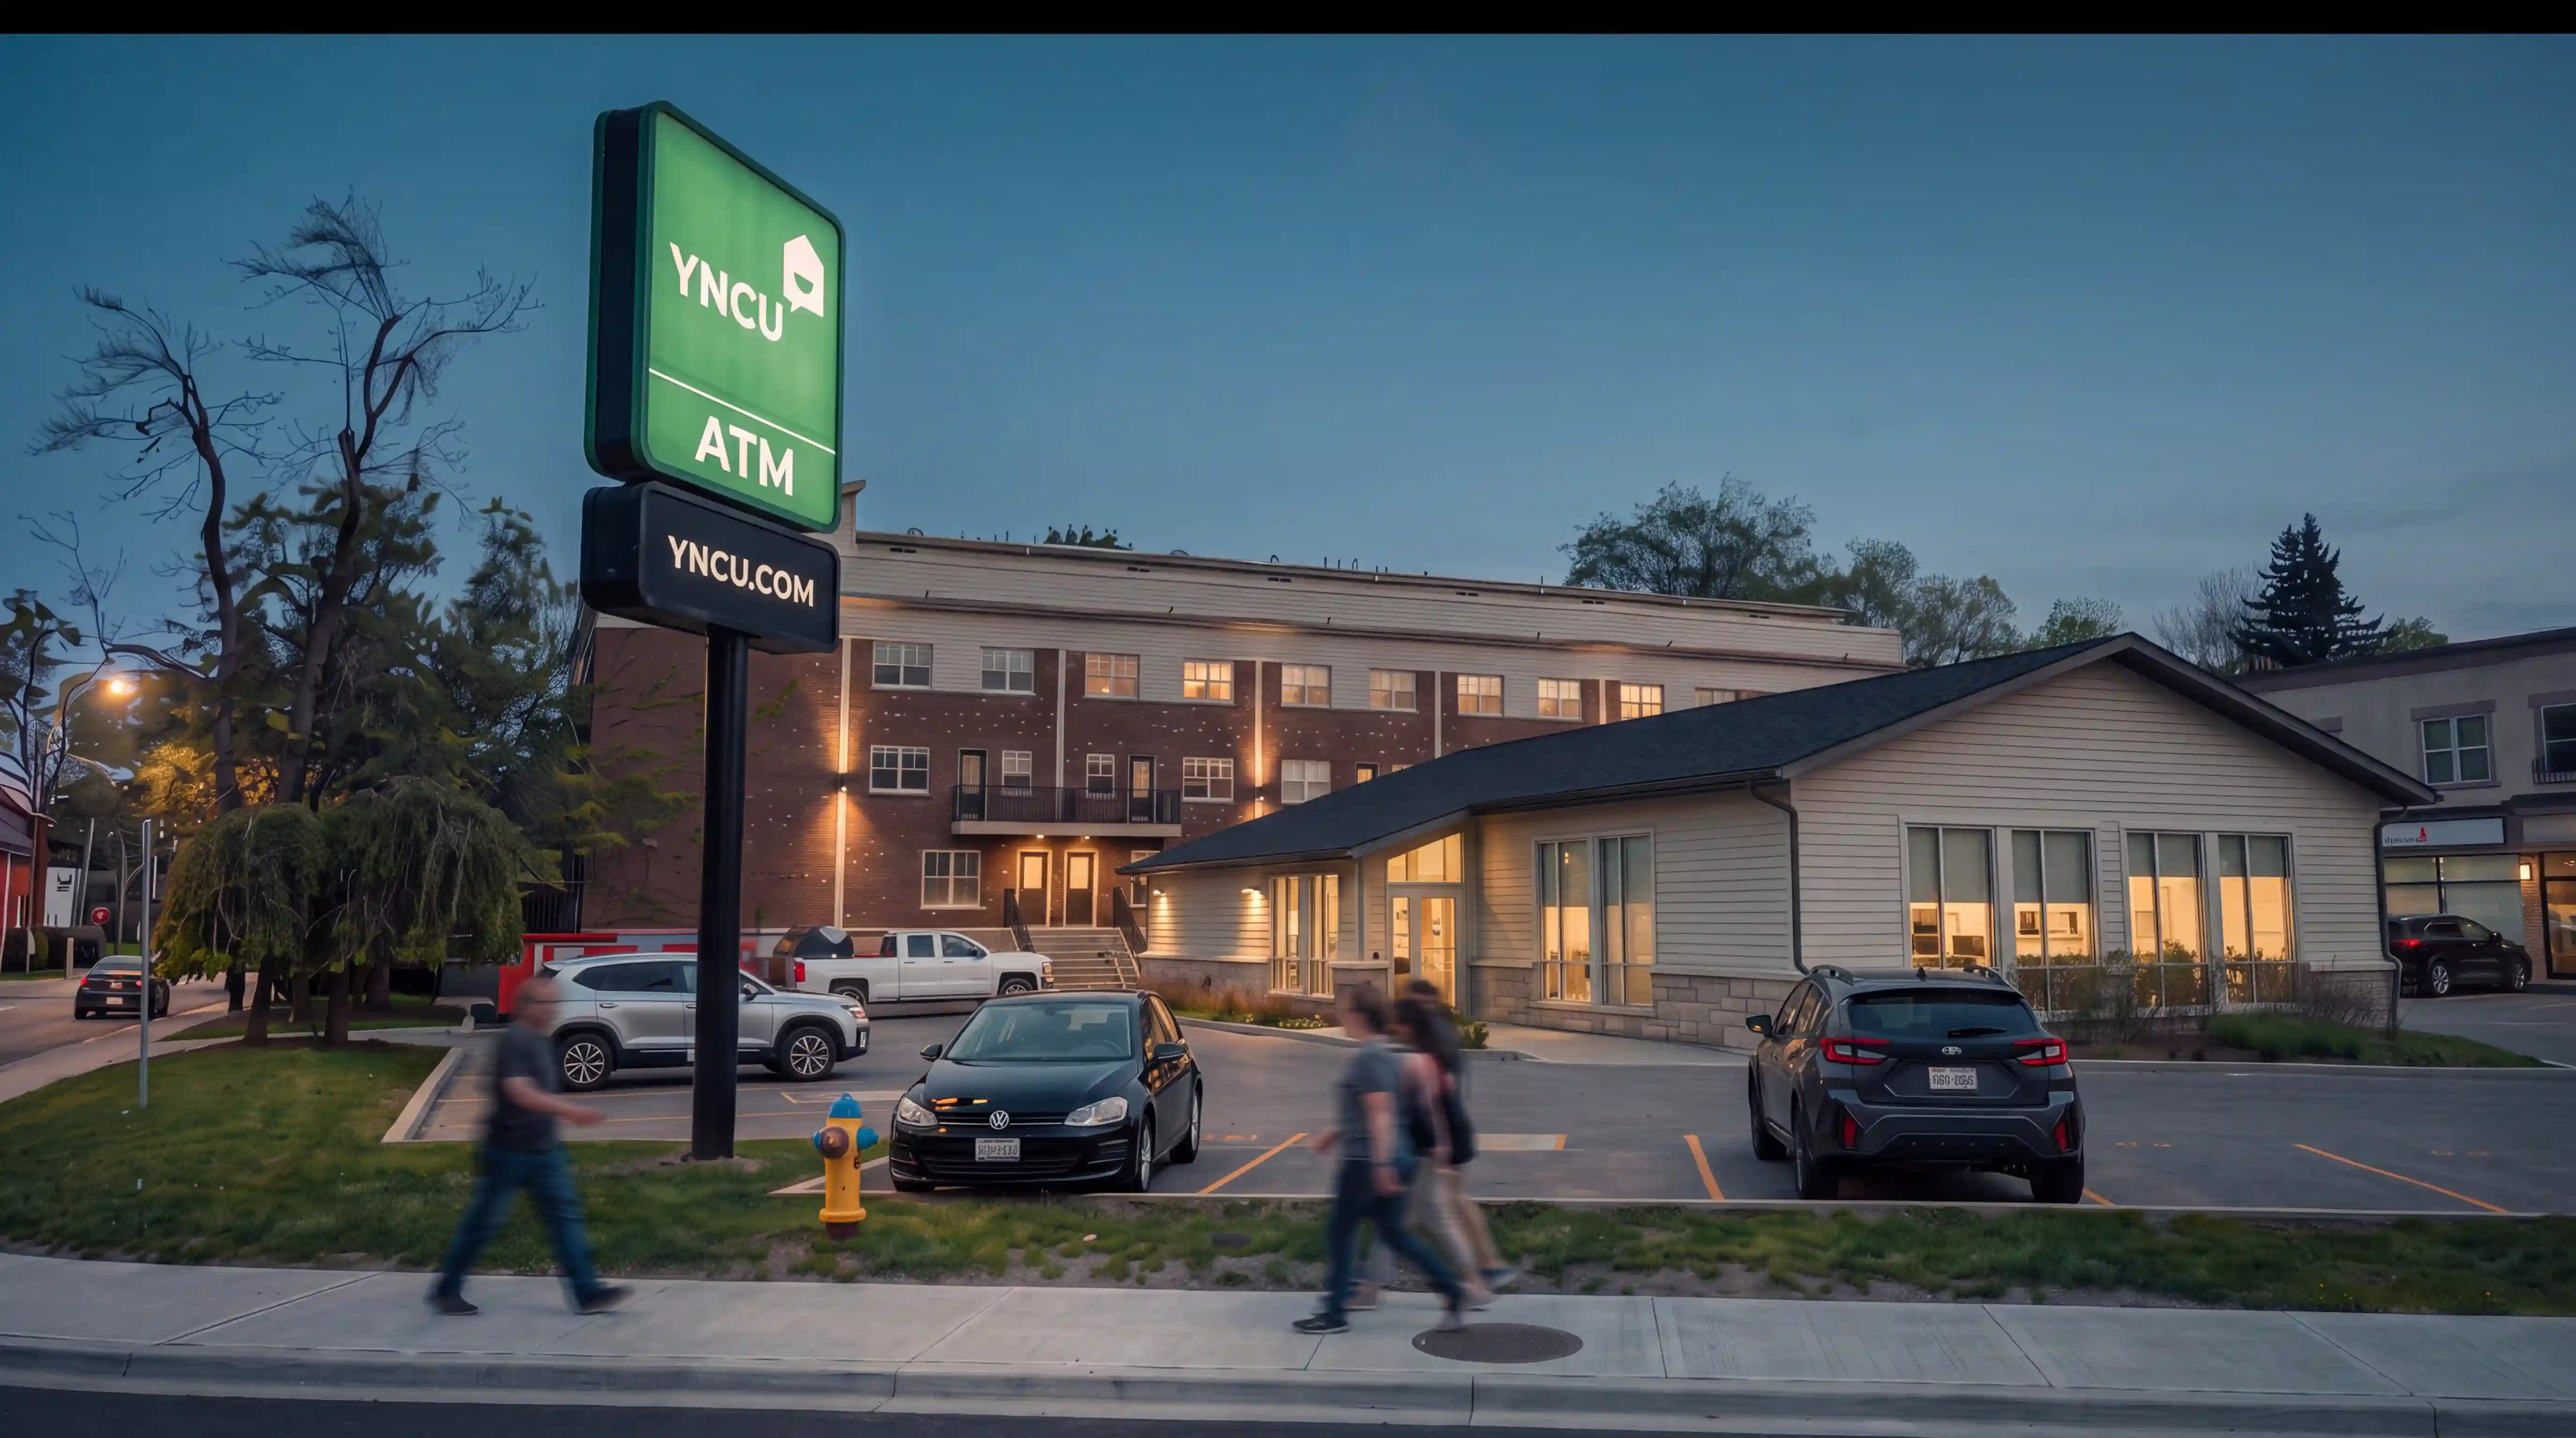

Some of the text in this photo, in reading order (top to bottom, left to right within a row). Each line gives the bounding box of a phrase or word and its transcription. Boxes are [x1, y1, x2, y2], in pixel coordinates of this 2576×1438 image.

[669, 242, 783, 342] YNCU
[695, 415, 794, 496] ATM
[667, 535, 814, 608] YNCU.COM
